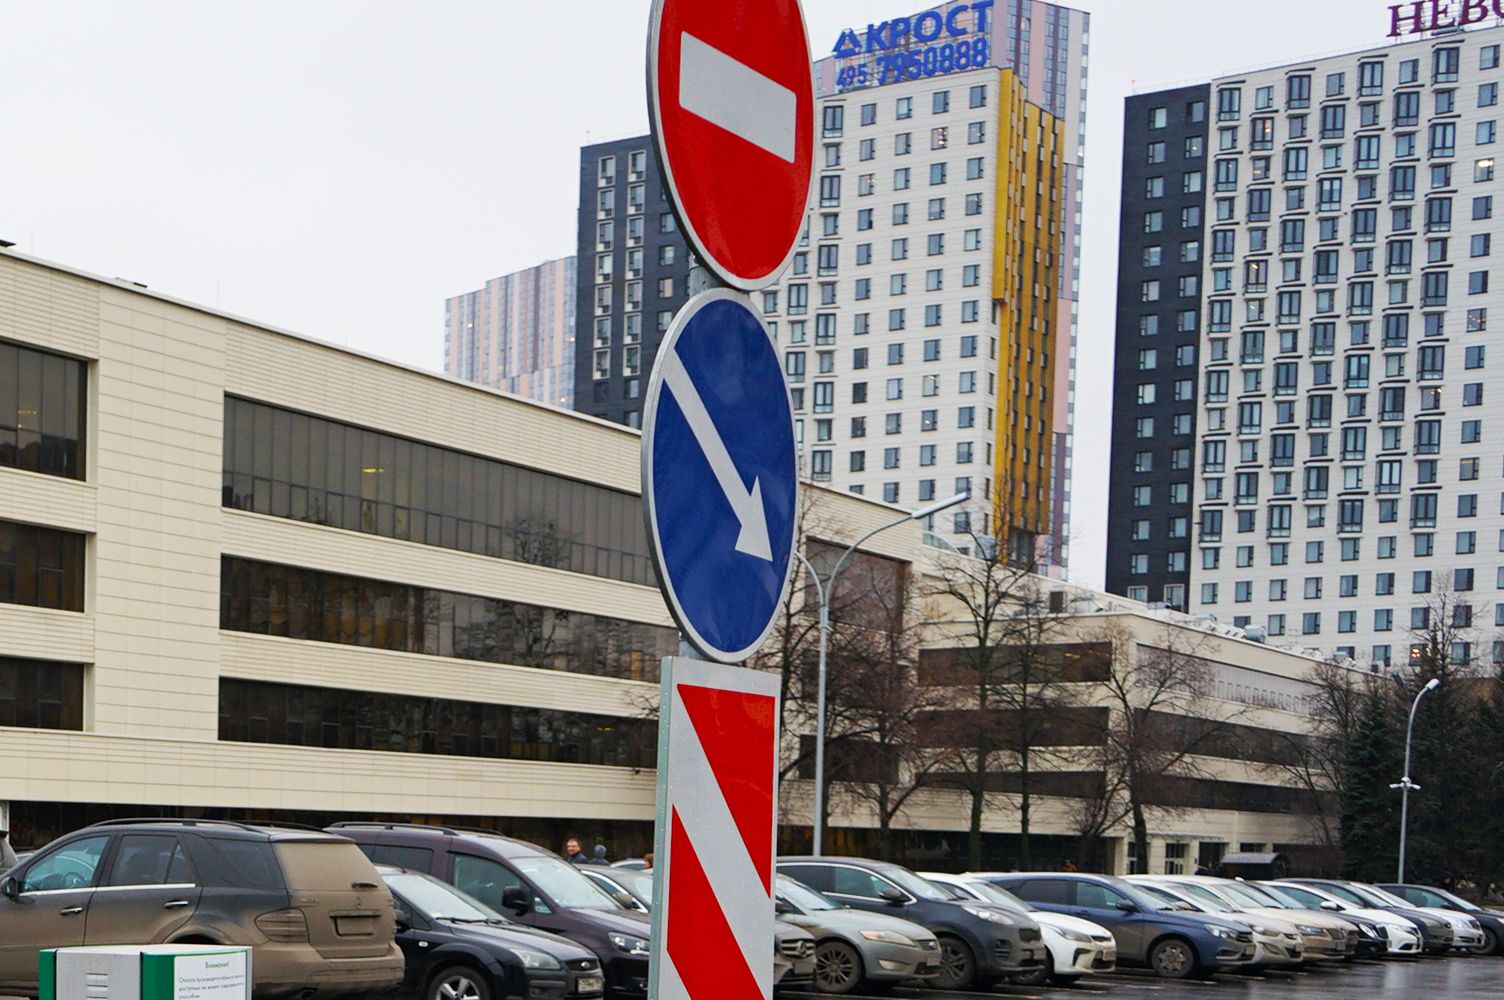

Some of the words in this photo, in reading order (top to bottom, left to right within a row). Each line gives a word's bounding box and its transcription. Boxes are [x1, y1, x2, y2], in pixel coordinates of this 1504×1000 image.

[866, 0, 994, 53] КРОСТ
[836, 63, 867, 87] 495
[876, 37, 988, 86] 7950888
